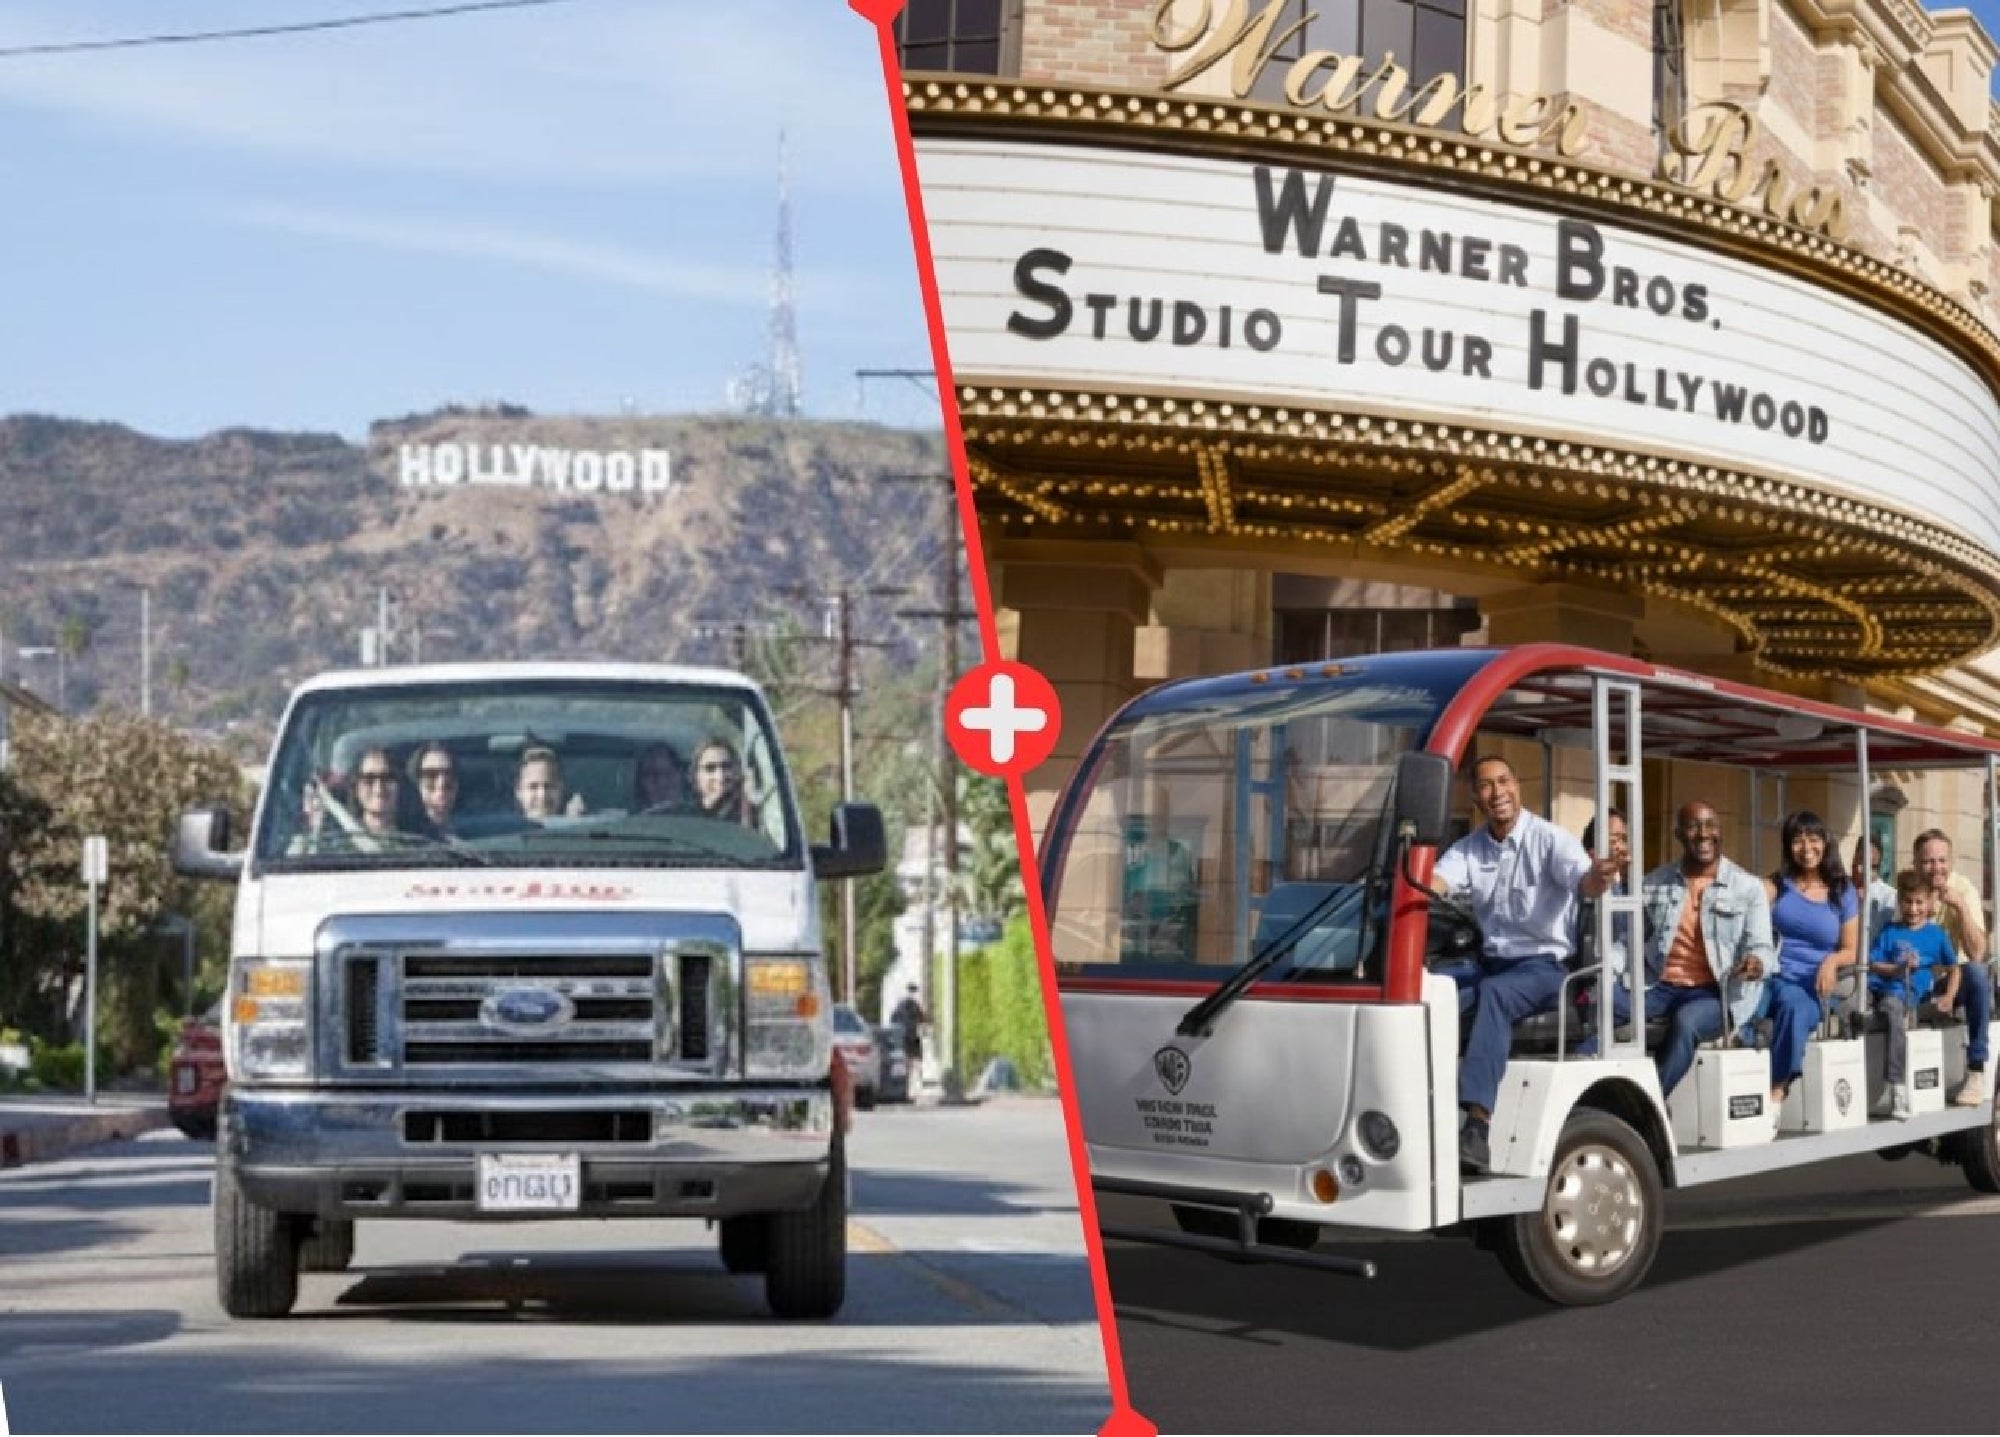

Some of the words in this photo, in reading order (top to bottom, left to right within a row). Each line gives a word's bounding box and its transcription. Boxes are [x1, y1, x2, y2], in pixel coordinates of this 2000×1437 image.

[1150, 0, 1590, 157] Warner
[1252, 165, 1529, 288] WARNER
[1007, 247, 1282, 352] STUDIO
[1317, 274, 1493, 378] TOUR
[1528, 309, 1829, 444] HOLLYWOOD
[399, 443, 672, 492] HOLLYWOOD
